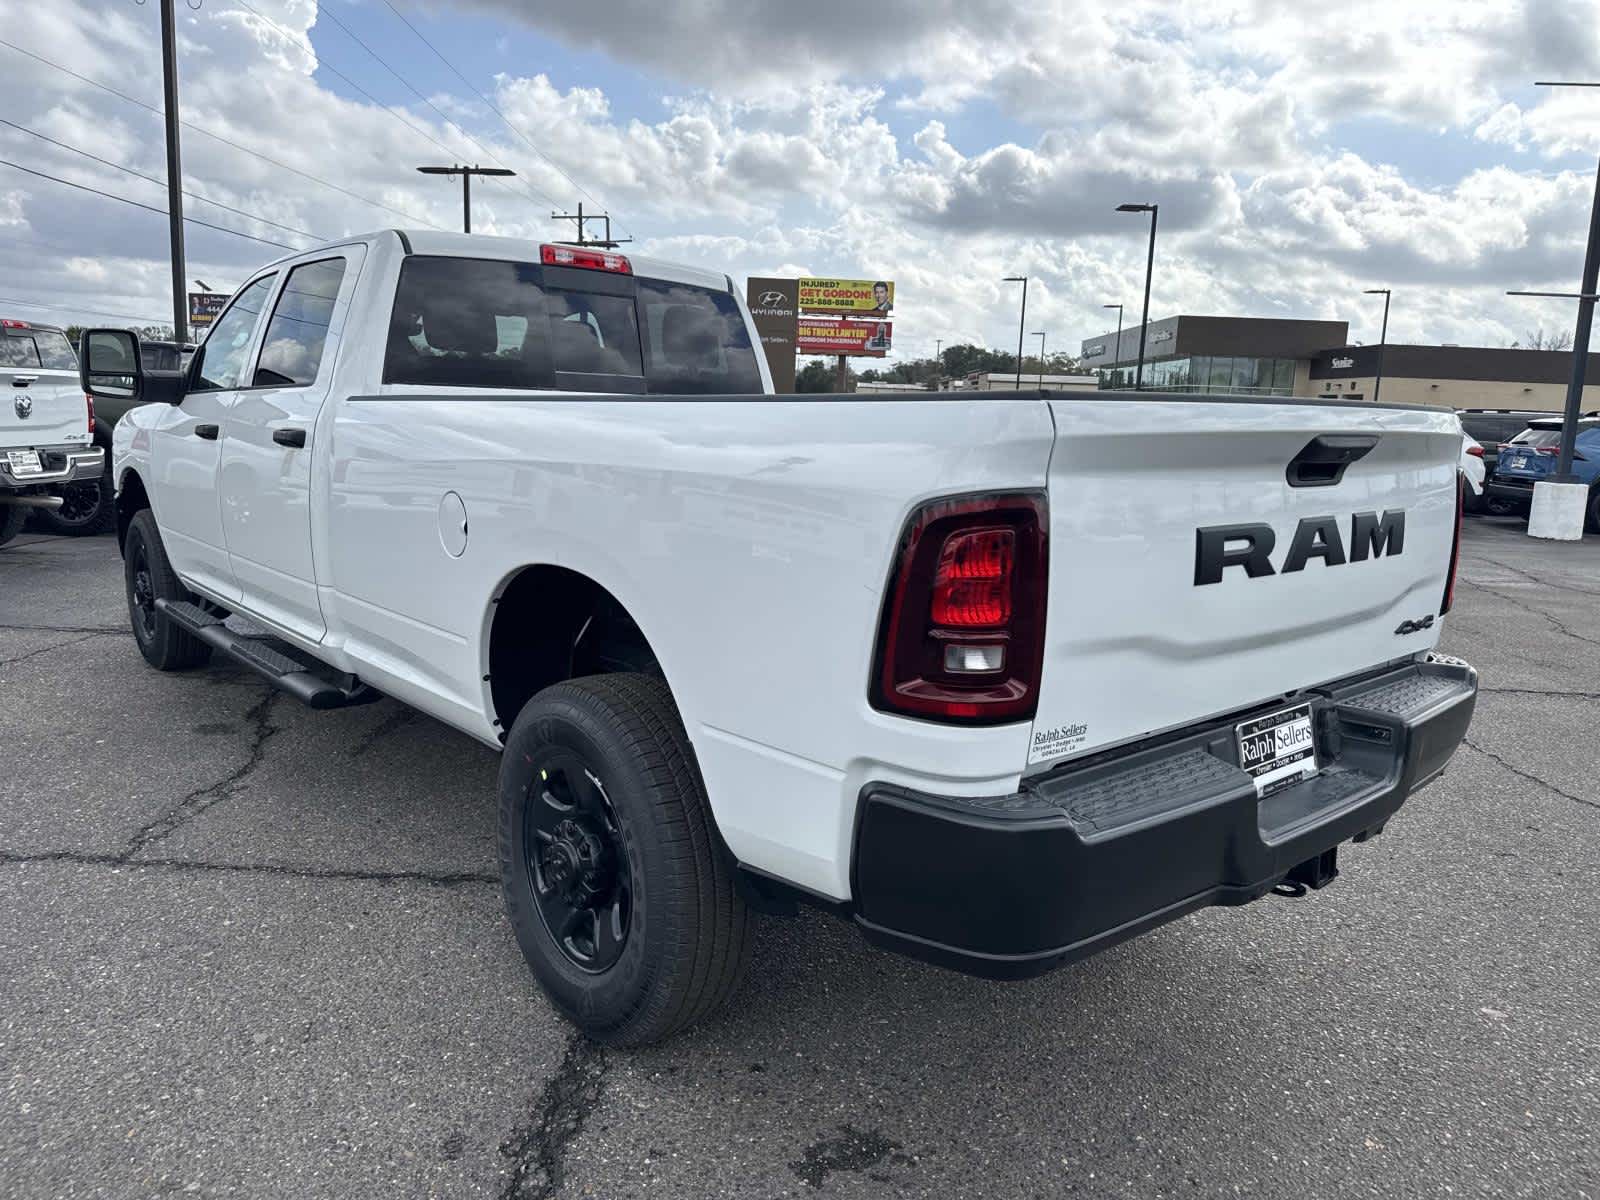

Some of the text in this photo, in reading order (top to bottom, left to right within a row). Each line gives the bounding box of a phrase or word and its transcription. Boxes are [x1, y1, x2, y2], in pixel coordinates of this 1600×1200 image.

[800, 280, 841, 289] INJURED?
[800, 288, 872, 300] GET GORDON!
[751, 307, 793, 317] HYUNDAI
[798, 320, 840, 328] LOUISIANA'S
[798, 326, 868, 339] BIG TRUCK LAWYER!
[798, 336, 826, 344] GORDON
[1193, 508, 1406, 587] RAM
[1393, 613, 1434, 636] 4x4
[1034, 724, 1088, 744] Ralph Sellers
[1240, 725, 1312, 763] Ralph Sellers
